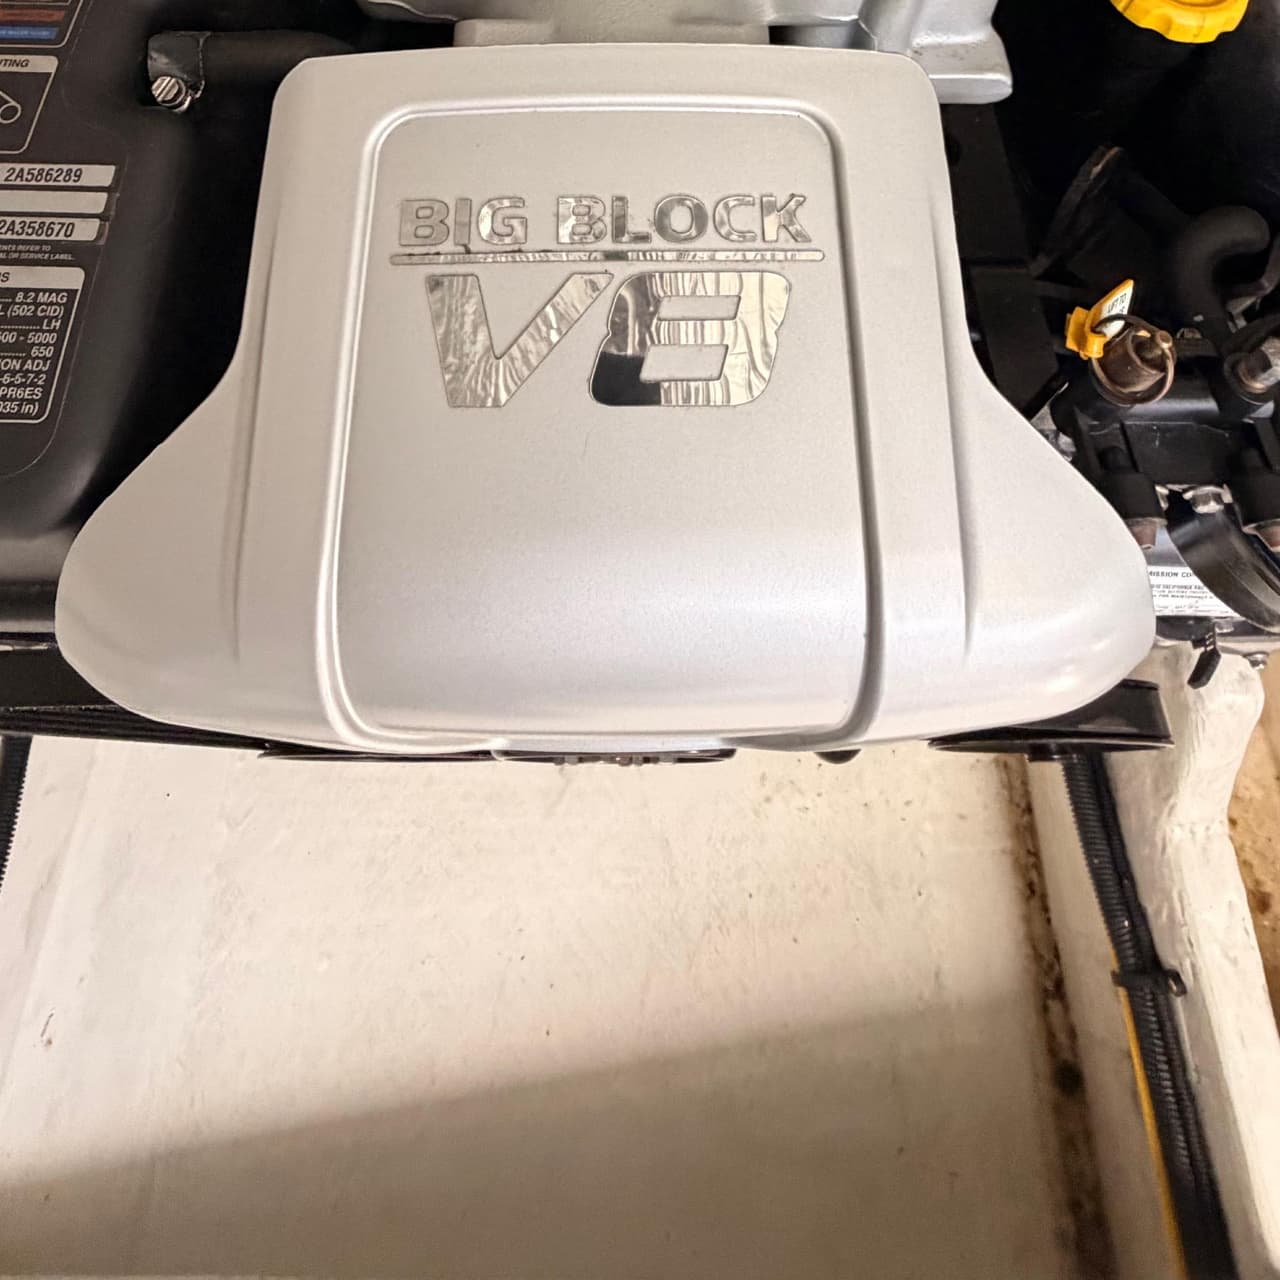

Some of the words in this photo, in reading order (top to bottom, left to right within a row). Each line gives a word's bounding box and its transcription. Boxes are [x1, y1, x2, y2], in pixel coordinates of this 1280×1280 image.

[3, 167, 83, 183] 2A586289
[399, 197, 528, 246] BIG
[557, 193, 812, 244] BLOCK
[15, 292, 35, 303] 8.2
[36, 292, 68, 303] MAG
[7, 305, 35, 318] (502
[37, 306, 64, 318] CID)
[42, 319, 61, 330] LH
[27, 332, 57, 344] 5000
[425, 271, 791, 407] V8
[31, 346, 54, 357] 650
[23, 359, 51, 371] ADJ
[20, 401, 39, 416] in)
